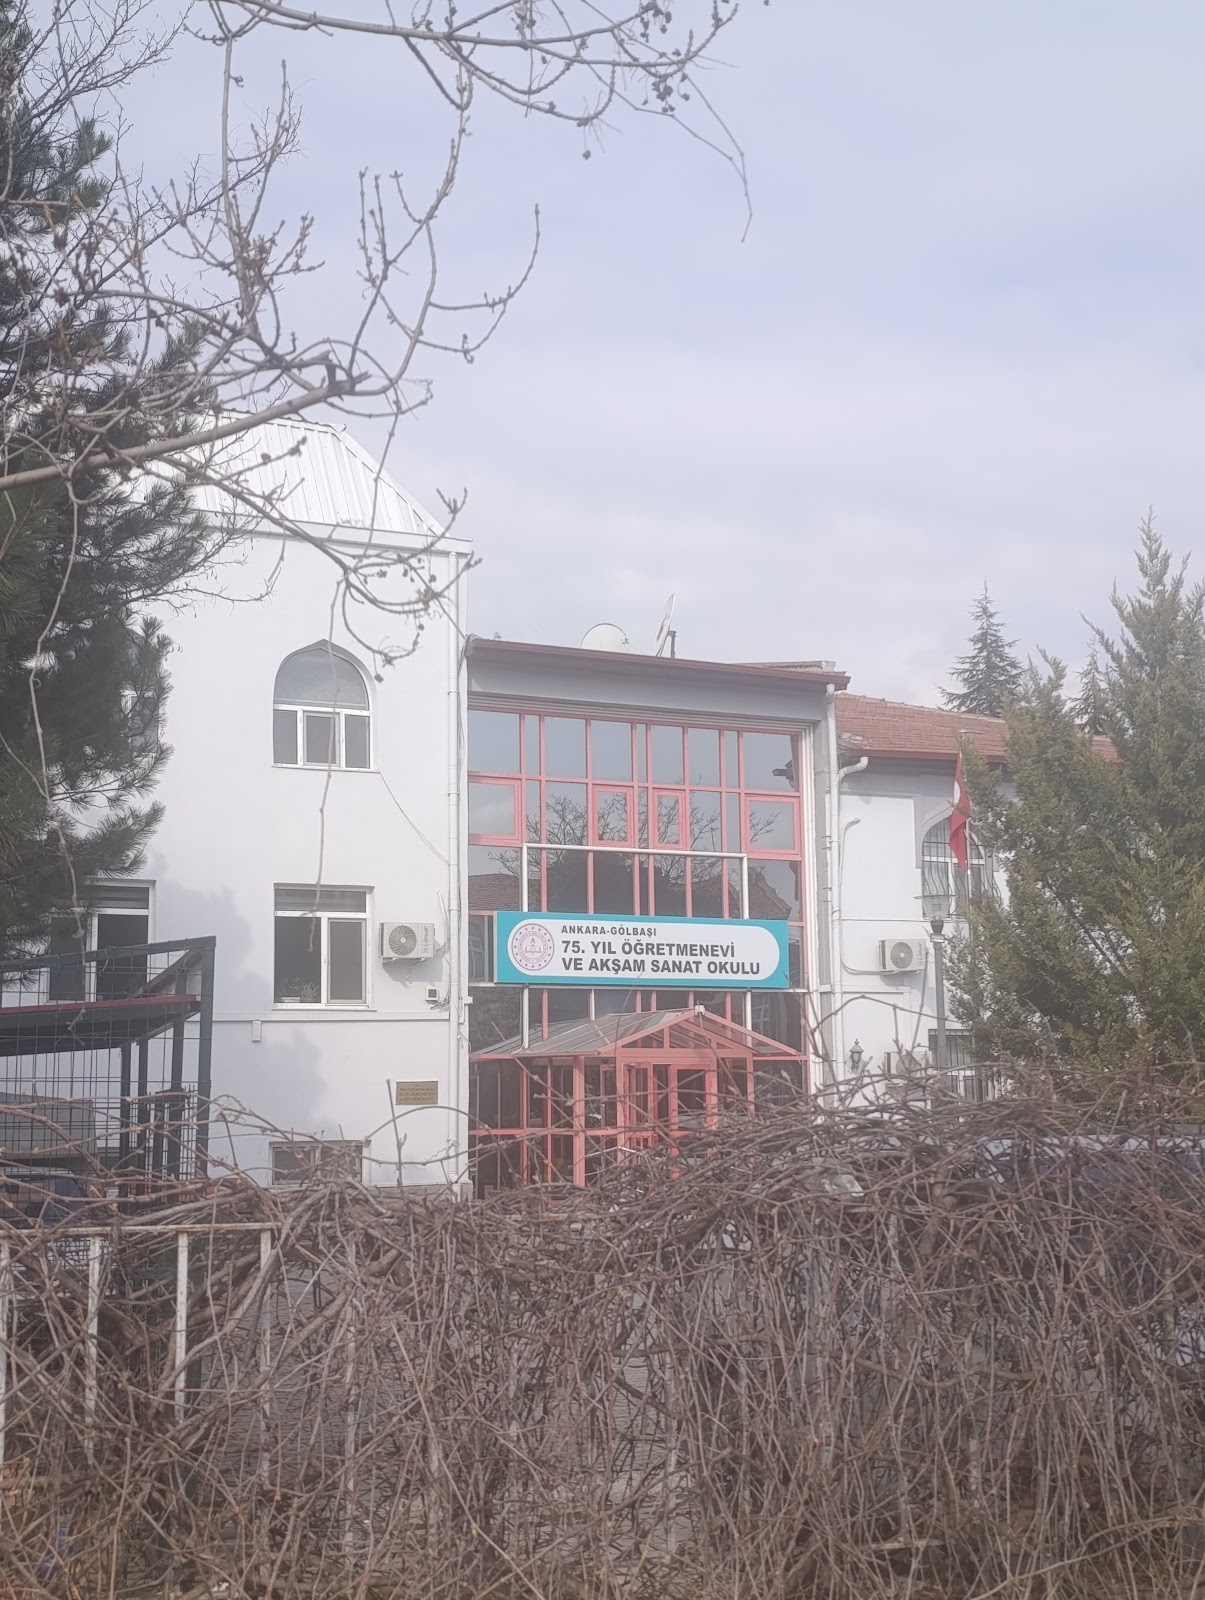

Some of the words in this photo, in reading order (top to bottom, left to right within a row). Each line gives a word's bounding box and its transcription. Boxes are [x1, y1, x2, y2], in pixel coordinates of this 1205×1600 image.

[561, 924, 656, 938] ANKARA-GÖLBAŞI
[561, 941, 585, 954] 75.
[590, 941, 617, 954] YIL
[621, 938, 735, 957] ÖĞRETMENEVİ
[561, 958, 583, 971] VE
[588, 959, 645, 974] AKŞAM
[651, 960, 702, 973] SANAT
[707, 961, 760, 975] OKULU
